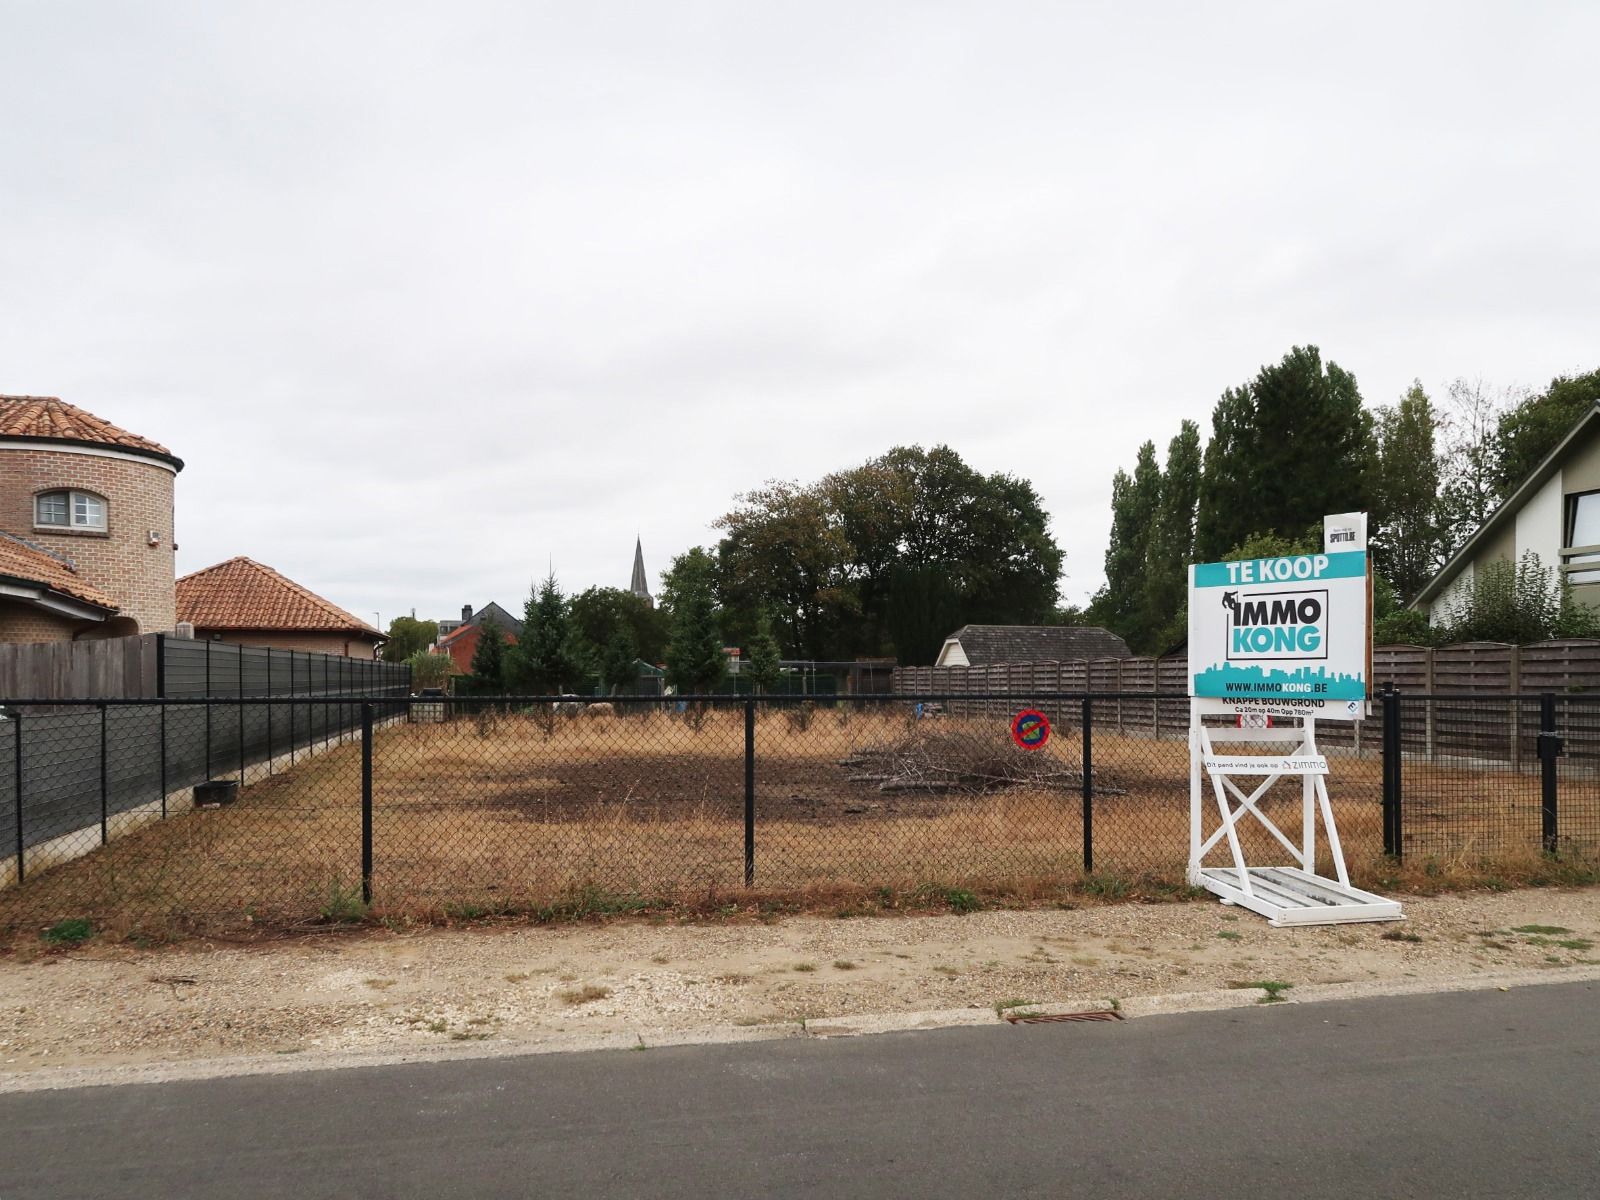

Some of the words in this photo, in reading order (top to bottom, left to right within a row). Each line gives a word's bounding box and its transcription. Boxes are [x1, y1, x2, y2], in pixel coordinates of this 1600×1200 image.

[1226, 562, 1254, 583] TE
[1260, 556, 1329, 581] KOOP
[1233, 598, 1322, 626] IMMO
[1233, 626, 1321, 653] KONG
[1225, 682, 1328, 693] WWW.IMMOKONG.BE
[1222, 696, 1260, 705] KNAPPE
[1261, 697, 1326, 708] BOUWGROND
